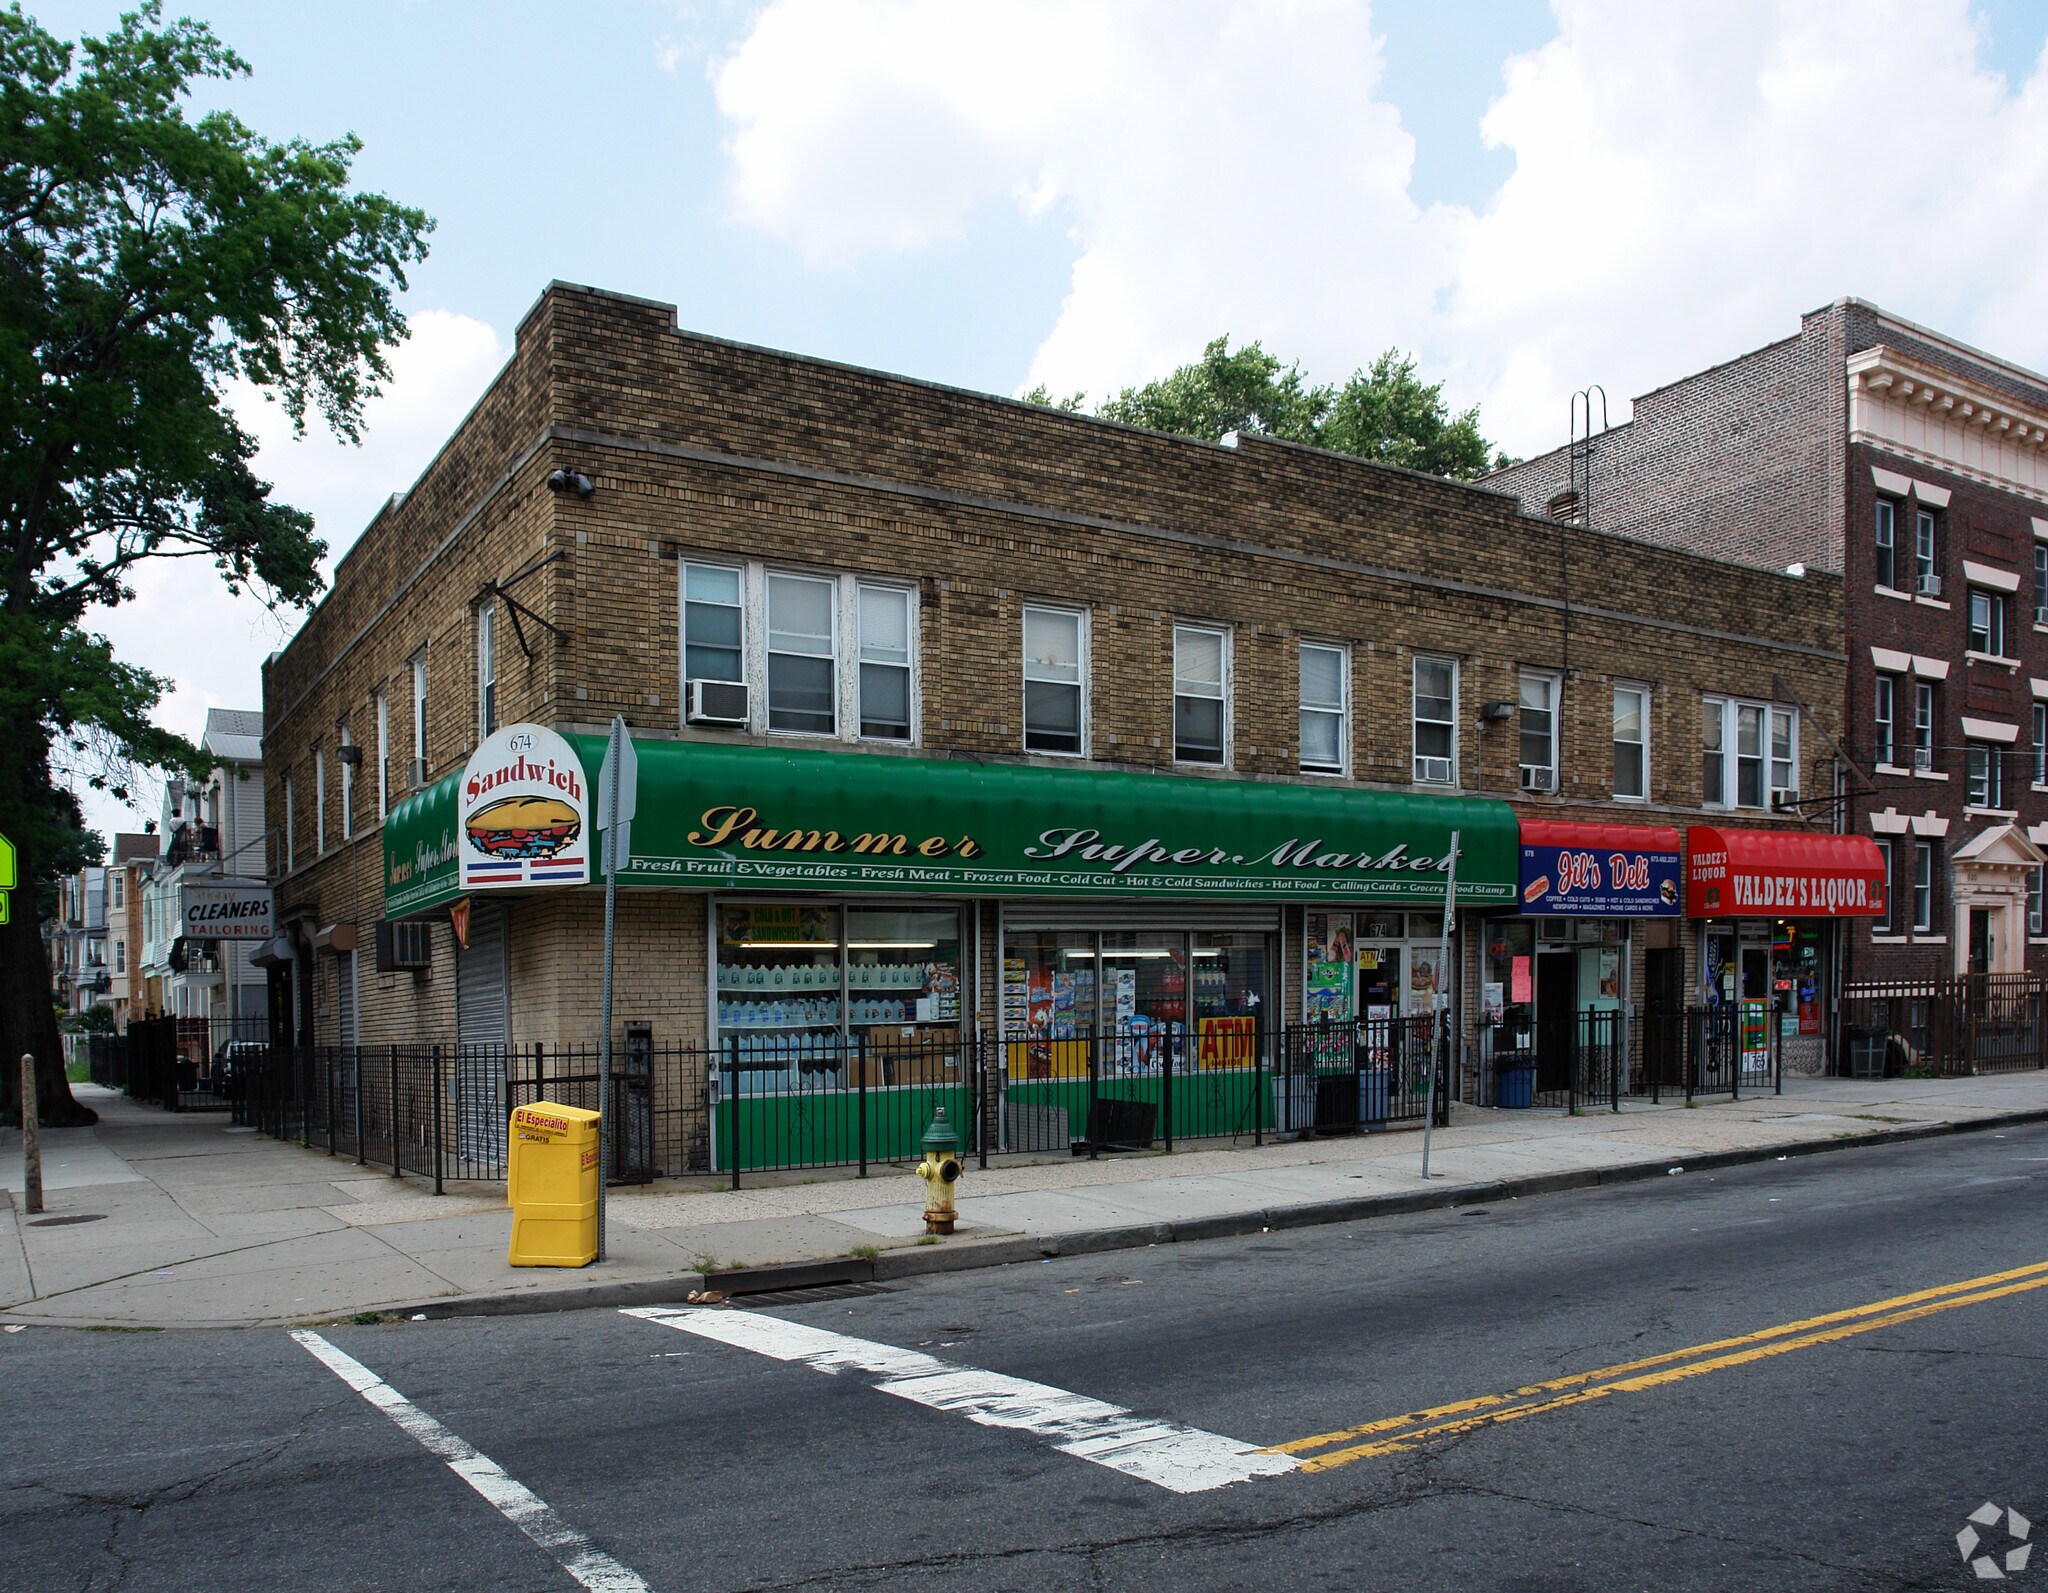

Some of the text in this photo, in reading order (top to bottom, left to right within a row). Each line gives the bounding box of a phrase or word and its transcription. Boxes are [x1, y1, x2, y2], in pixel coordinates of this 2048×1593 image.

[510, 734, 532, 750] 674
[466, 755, 581, 807] Sandwich
[687, 806, 1462, 872] Summer Super Market
[1692, 851, 1727, 866] VALDEZ'S
[631, 858, 682, 872] Fresh
[686, 860, 733, 874] Fruit
[736, 863, 753, 875] &
[753, 863, 848, 879] Vegetables
[861, 867, 905, 880] Fresh
[909, 869, 951, 881] Meat
[963, 871, 1013, 883] Frozen
[1017, 872, 1050, 884] Food
[1060, 874, 1090, 885] Cold
[1092, 875, 1116, 886] Cut
[1126, 876, 1149, 886] Hot
[1151, 877, 1163, 887] &
[1165, 877, 1193, 888] Cold
[1195, 878, 1264, 889] Sandwiches
[1272, 880, 1293, 889] Hot
[1295, 880, 1319, 889] Food
[1332, 881, 1370, 892] Calling
[1370, 882, 1401, 892] Cards
[1409, 883, 1444, 895] Grocery
[1474, 885, 1505, 896] Stamp
[1558, 850, 1650, 895] Jil's Deli
[1692, 866, 1726, 882] LIQUOR
[1733, 875, 1867, 914] VALDEZ'S LIQUOR
[188, 900, 270, 921] CLEANERS
[754, 907, 773, 922] COLD
[782, 907, 795, 922] HOT
[189, 924, 269, 935] TAILORING
[752, 926, 800, 941] SANDWICHES
[1370, 924, 1386, 937] 674
[1202, 1019, 1253, 1059] ATM
[517, 1111, 525, 1122] El
[526, 1112, 568, 1131] Especialito
[525, 1134, 550, 1144] GRATIS
